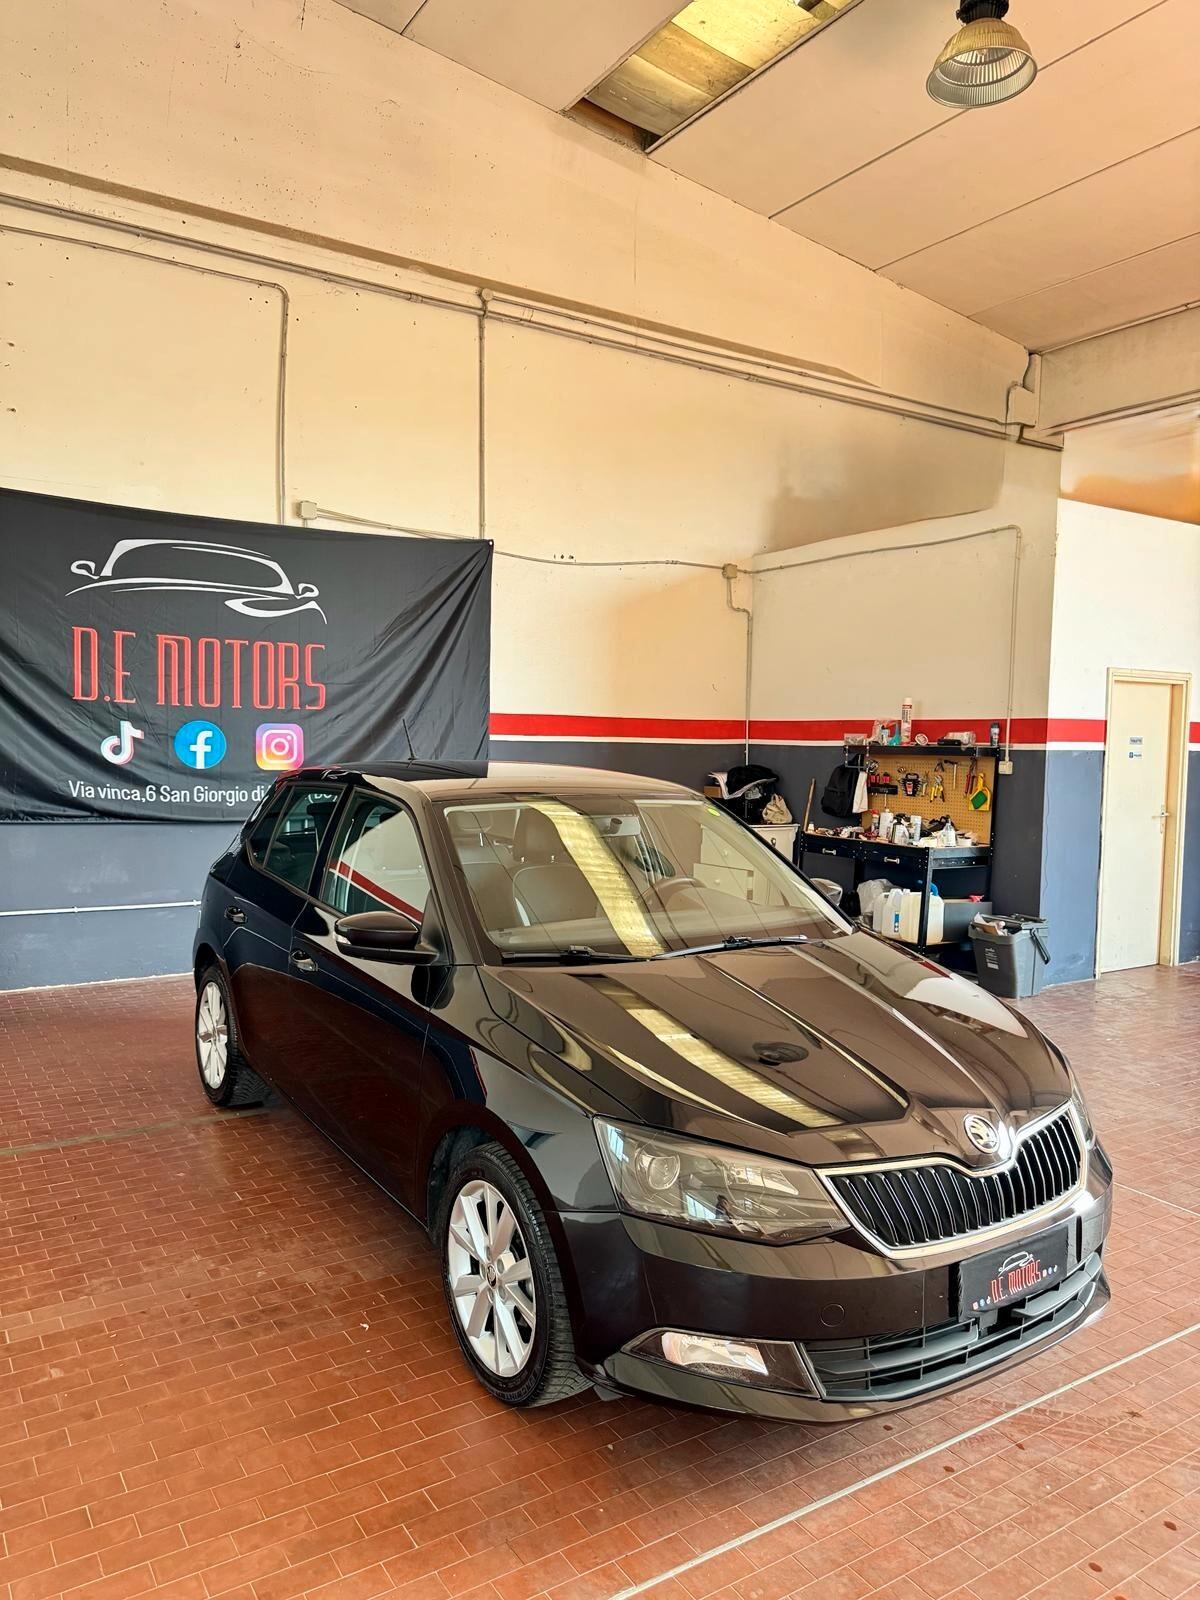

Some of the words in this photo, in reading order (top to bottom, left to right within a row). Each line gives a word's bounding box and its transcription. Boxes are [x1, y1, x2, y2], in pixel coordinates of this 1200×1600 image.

[71, 626, 136, 704] D.E
[155, 633, 327, 711] MOTORS
[68, 780, 95, 798] Via
[159, 785, 190, 803] San
[193, 785, 248, 807] Giorgio
[251, 785, 265, 802] di
[1008, 1259, 1042, 1296] MOTORS
